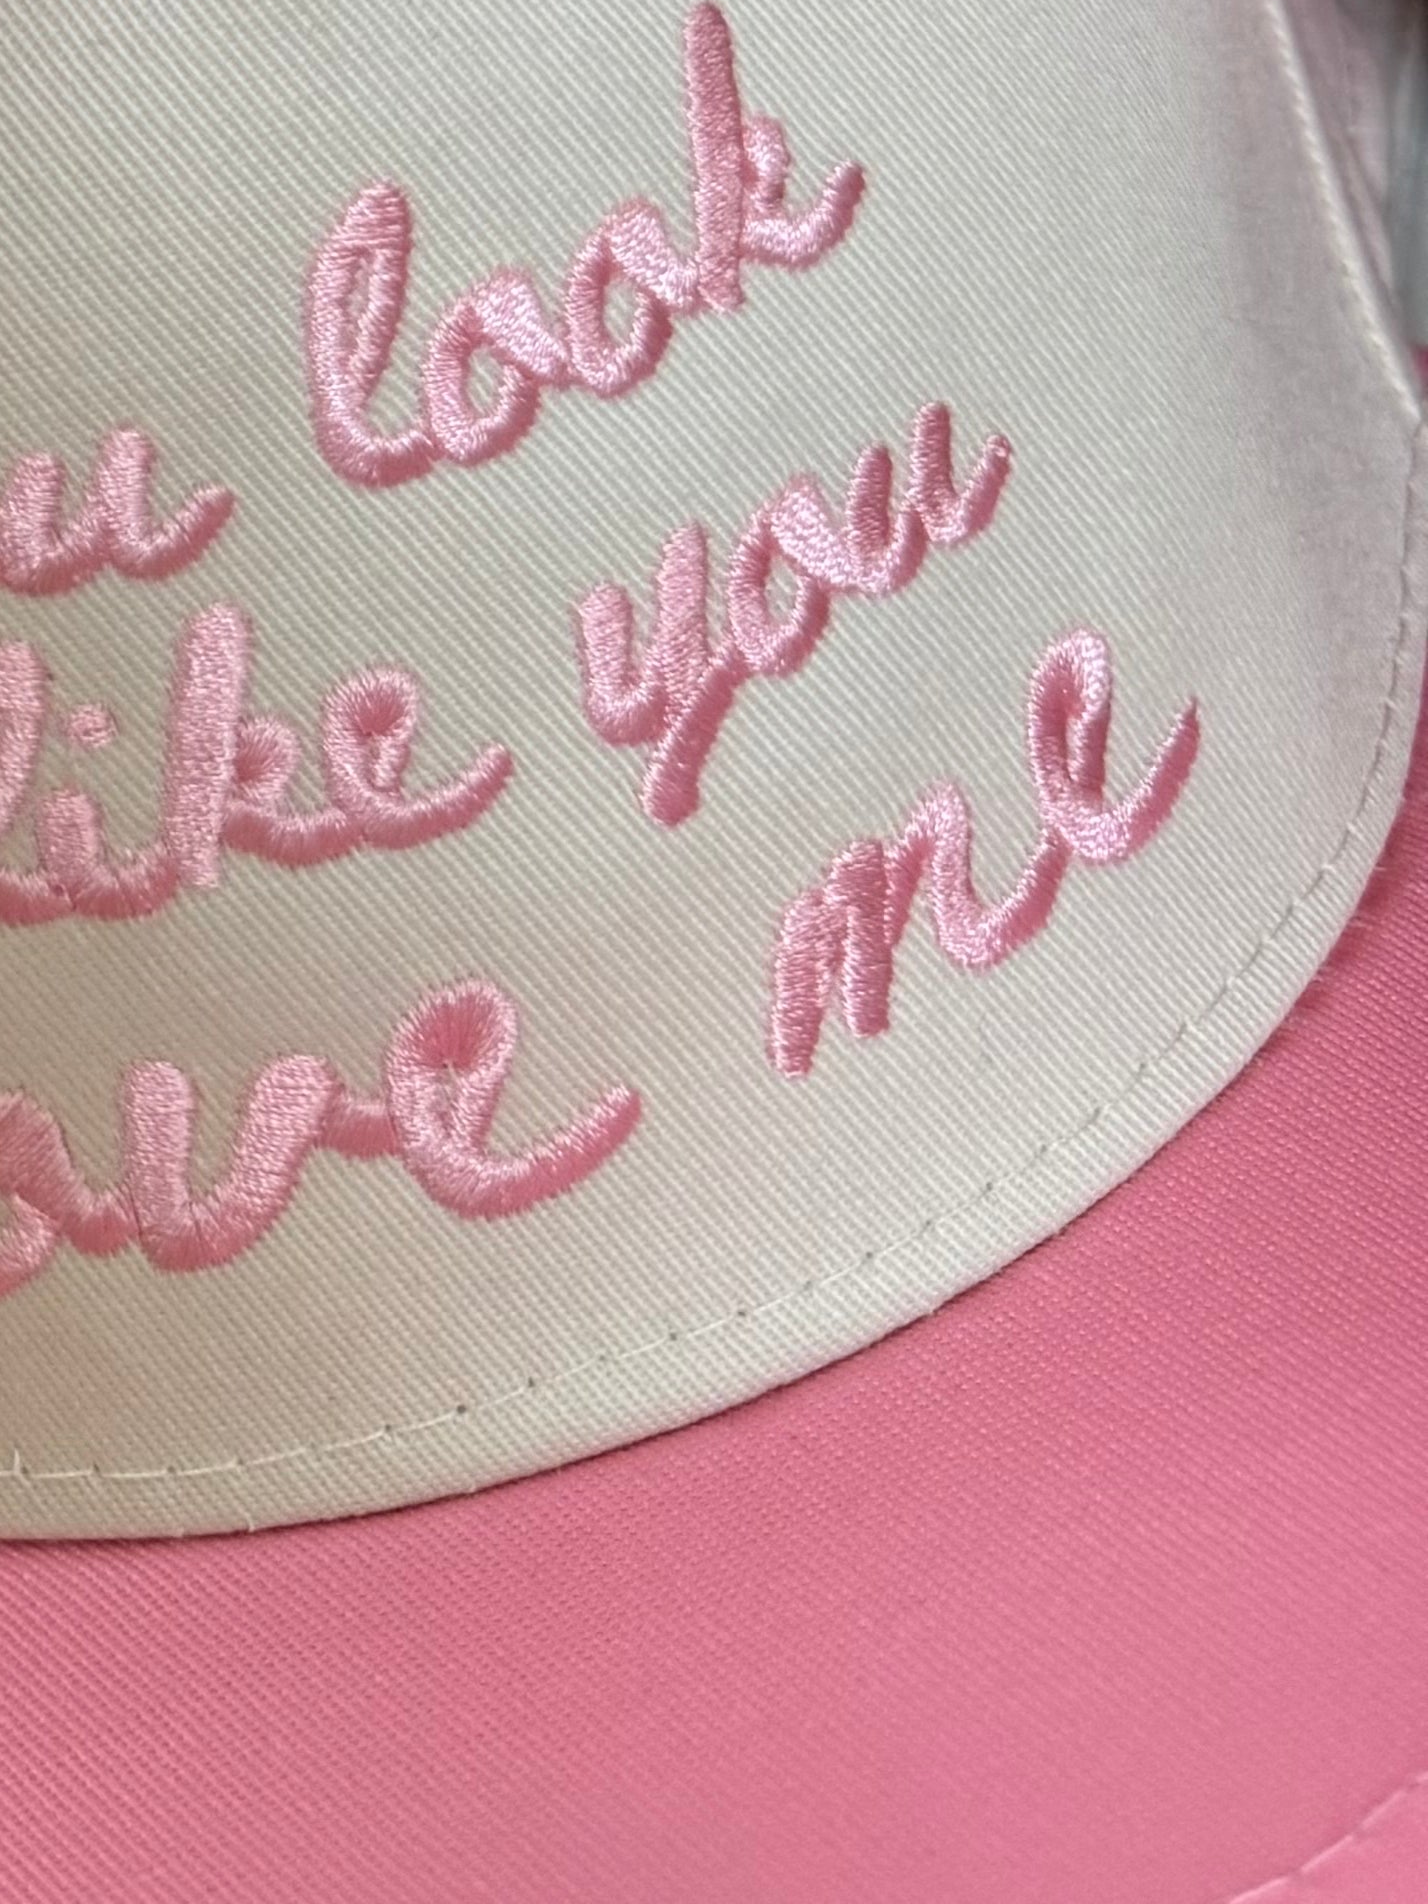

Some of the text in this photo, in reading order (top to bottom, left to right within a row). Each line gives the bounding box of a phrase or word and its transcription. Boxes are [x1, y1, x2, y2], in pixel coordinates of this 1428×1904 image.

[301, 0, 868, 493] look
[574, 404, 1013, 831] you
[765, 632, 1203, 1080] me
